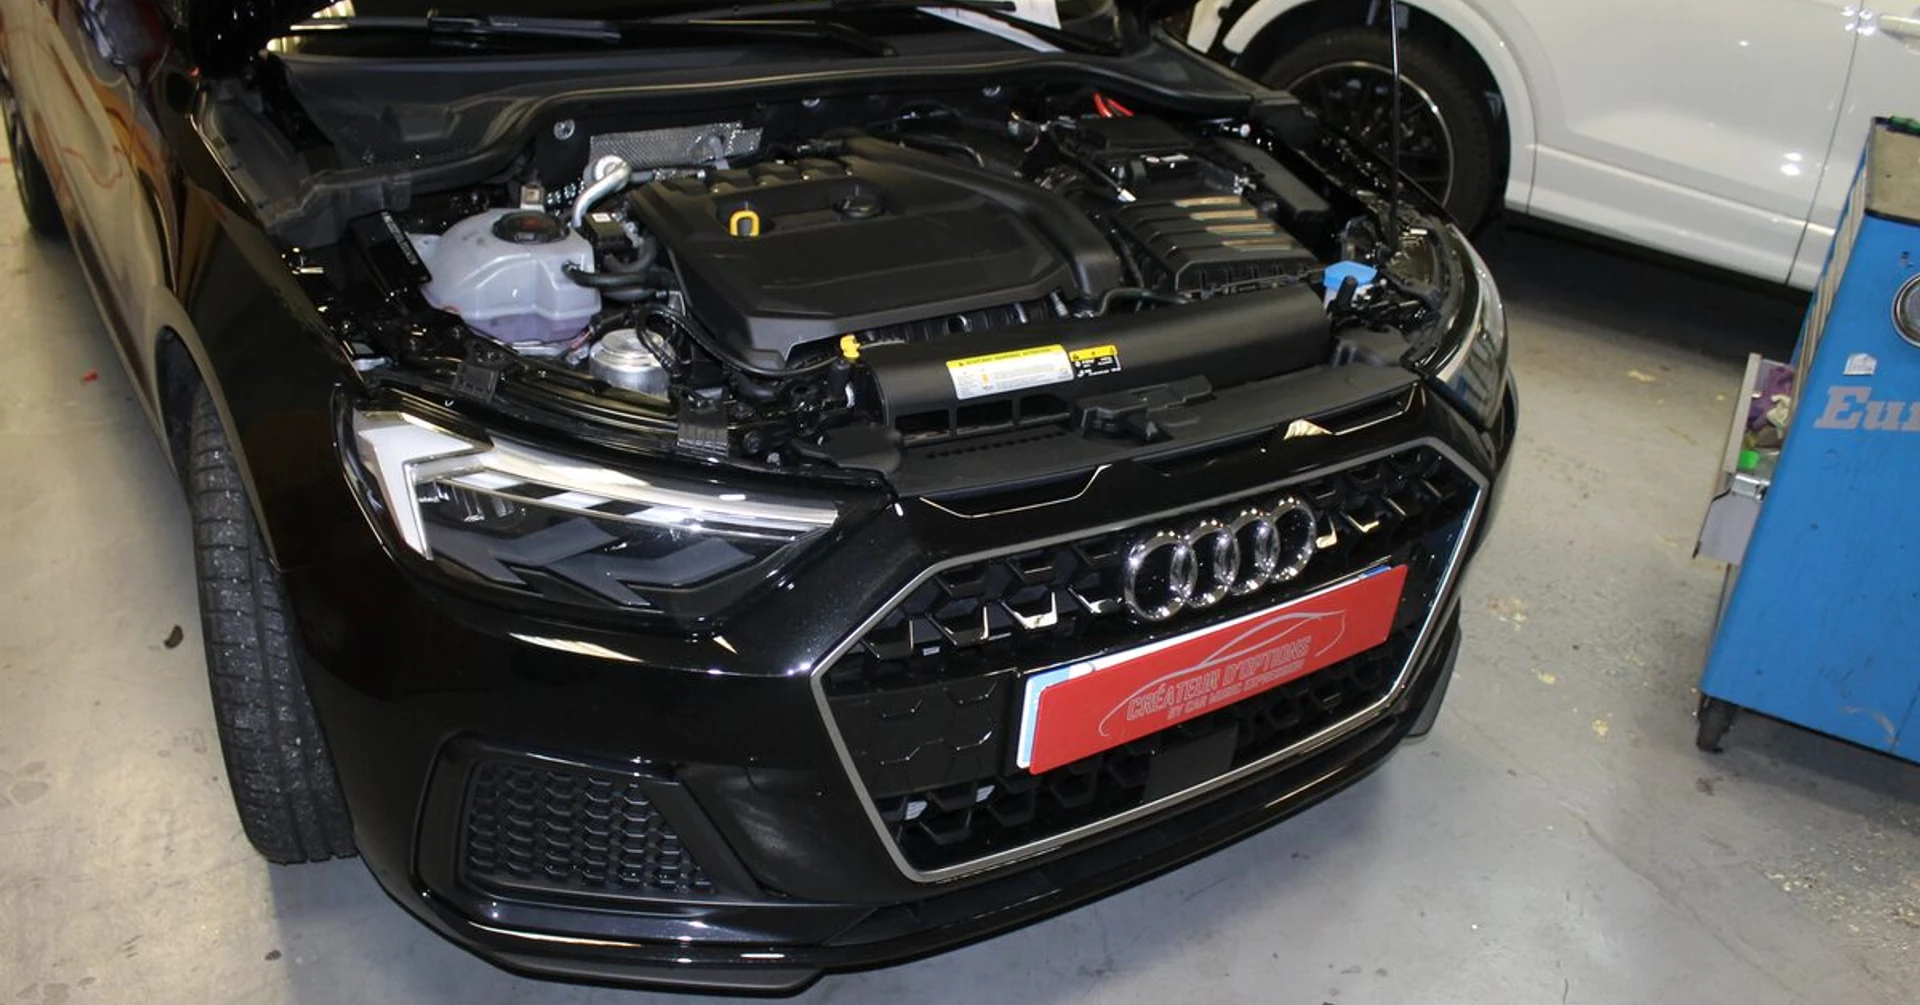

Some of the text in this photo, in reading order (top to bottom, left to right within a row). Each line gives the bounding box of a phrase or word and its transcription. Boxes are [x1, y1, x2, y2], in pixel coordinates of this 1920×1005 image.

[1127, 635, 1312, 720] CRÉATEUR D'OPTIONS
[1167, 704, 1184, 720] BY
